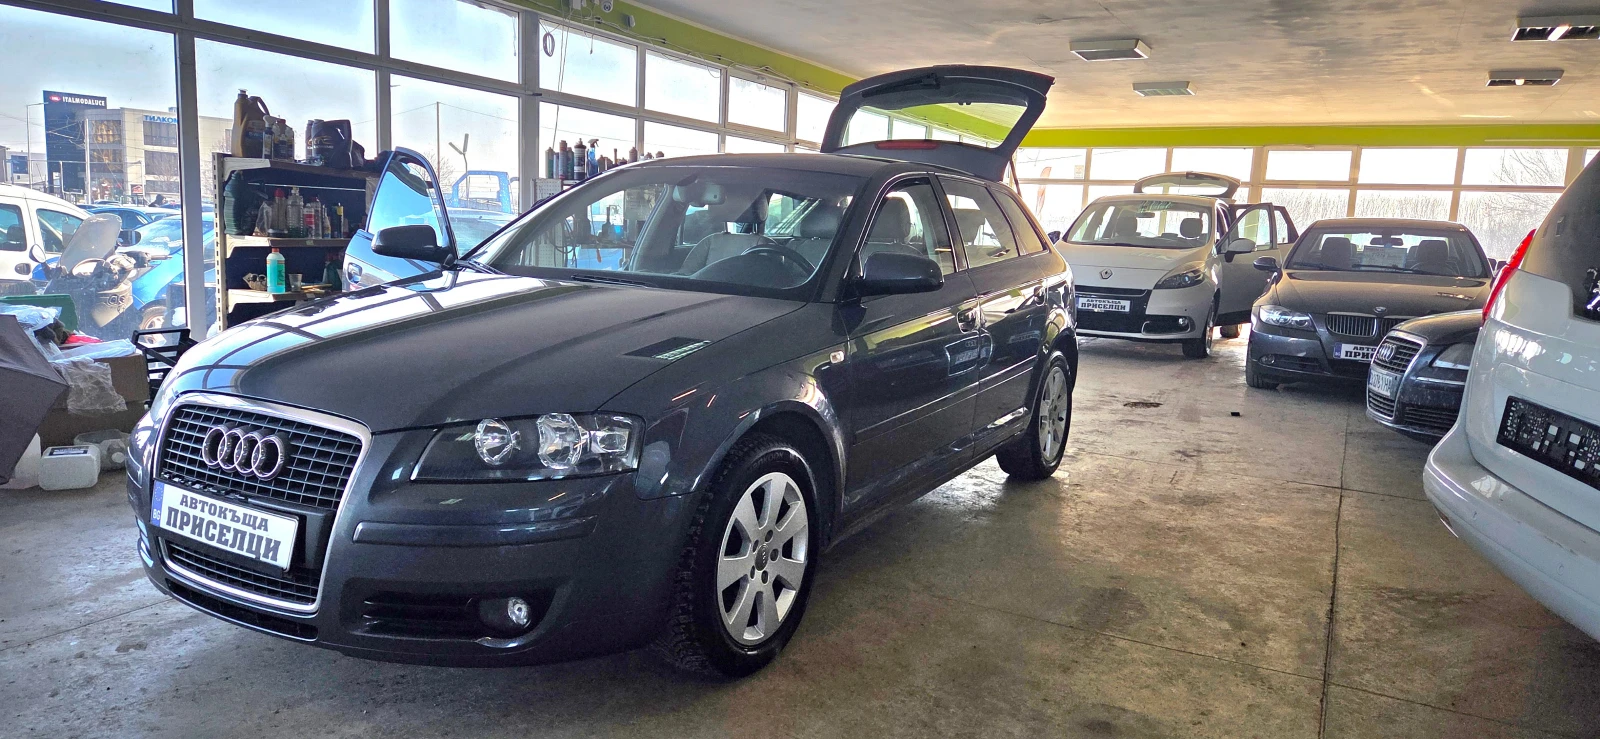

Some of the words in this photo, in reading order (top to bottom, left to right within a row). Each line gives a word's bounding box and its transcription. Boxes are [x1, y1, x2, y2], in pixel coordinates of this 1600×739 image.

[62, 96, 105, 106] ITALMODALUCE
[152, 508, 161, 520] BG
[180, 494, 269, 532] АВТОКЪЩА
[166, 506, 281, 562] ПРИСЕЛЦИ
